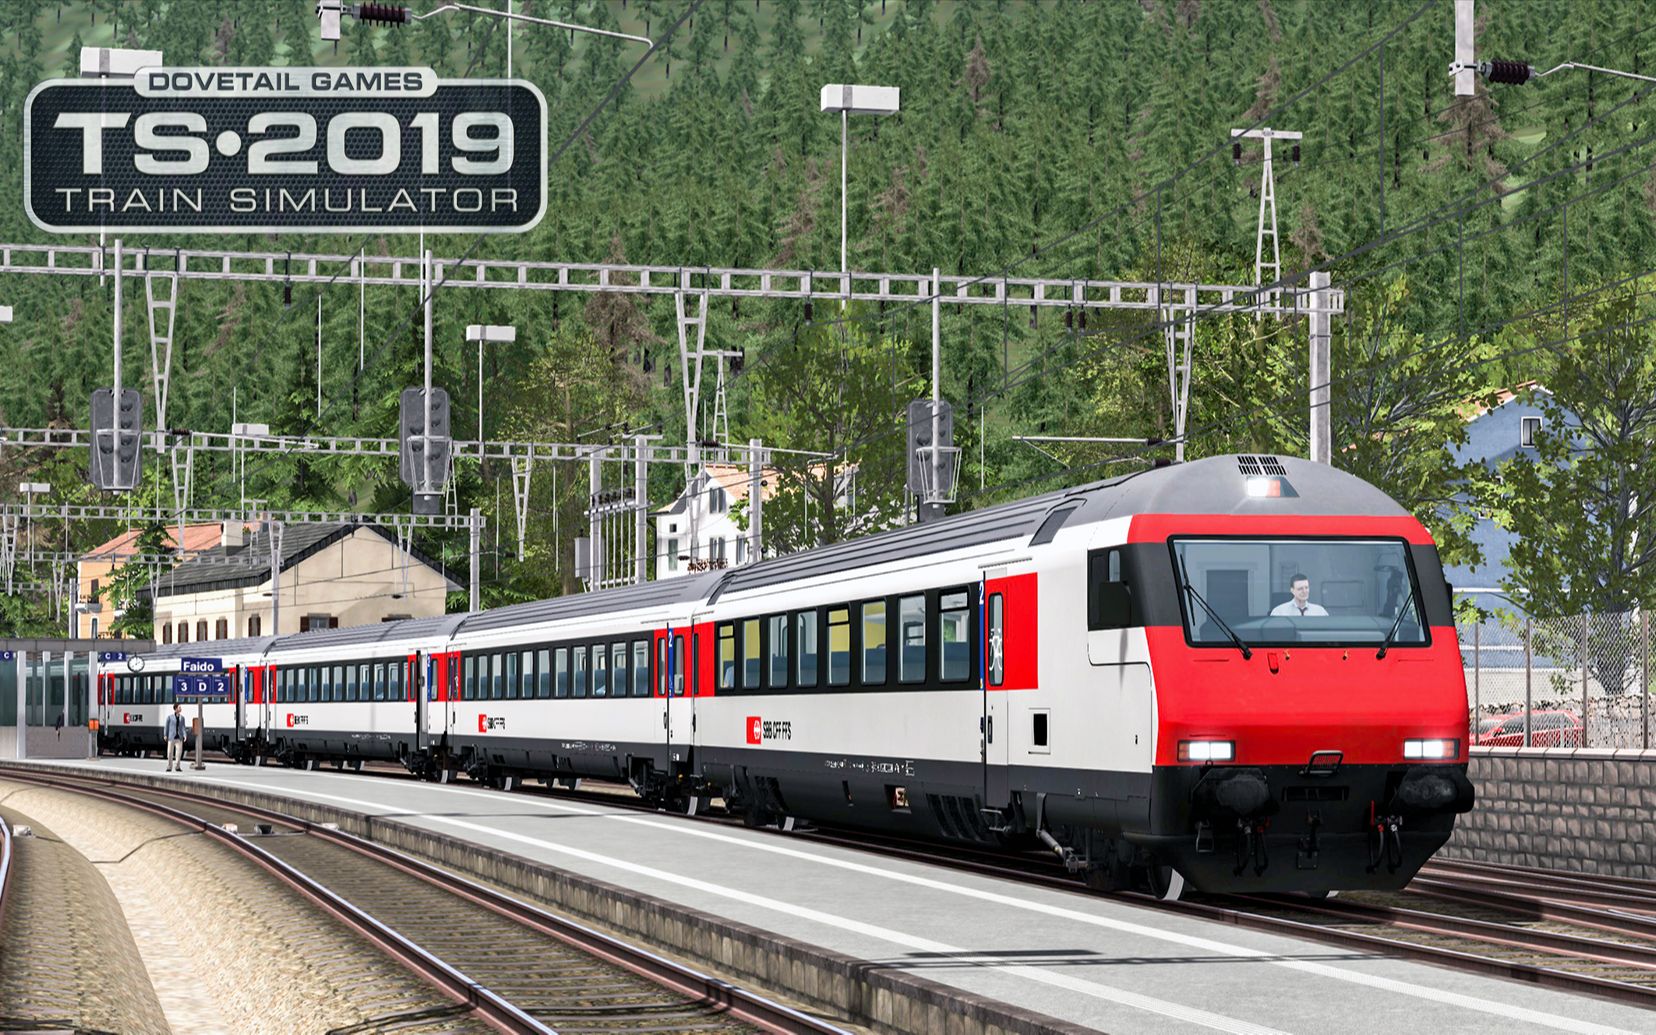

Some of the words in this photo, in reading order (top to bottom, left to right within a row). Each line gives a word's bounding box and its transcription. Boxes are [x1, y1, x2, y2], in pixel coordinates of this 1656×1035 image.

[979, 581, 984, 605] 2
[668, 631, 673, 648] 2
[183, 661, 215, 672] Faido
[181, 682, 188, 692] 3
[198, 682, 207, 692] D
[217, 682, 225, 692] 2
